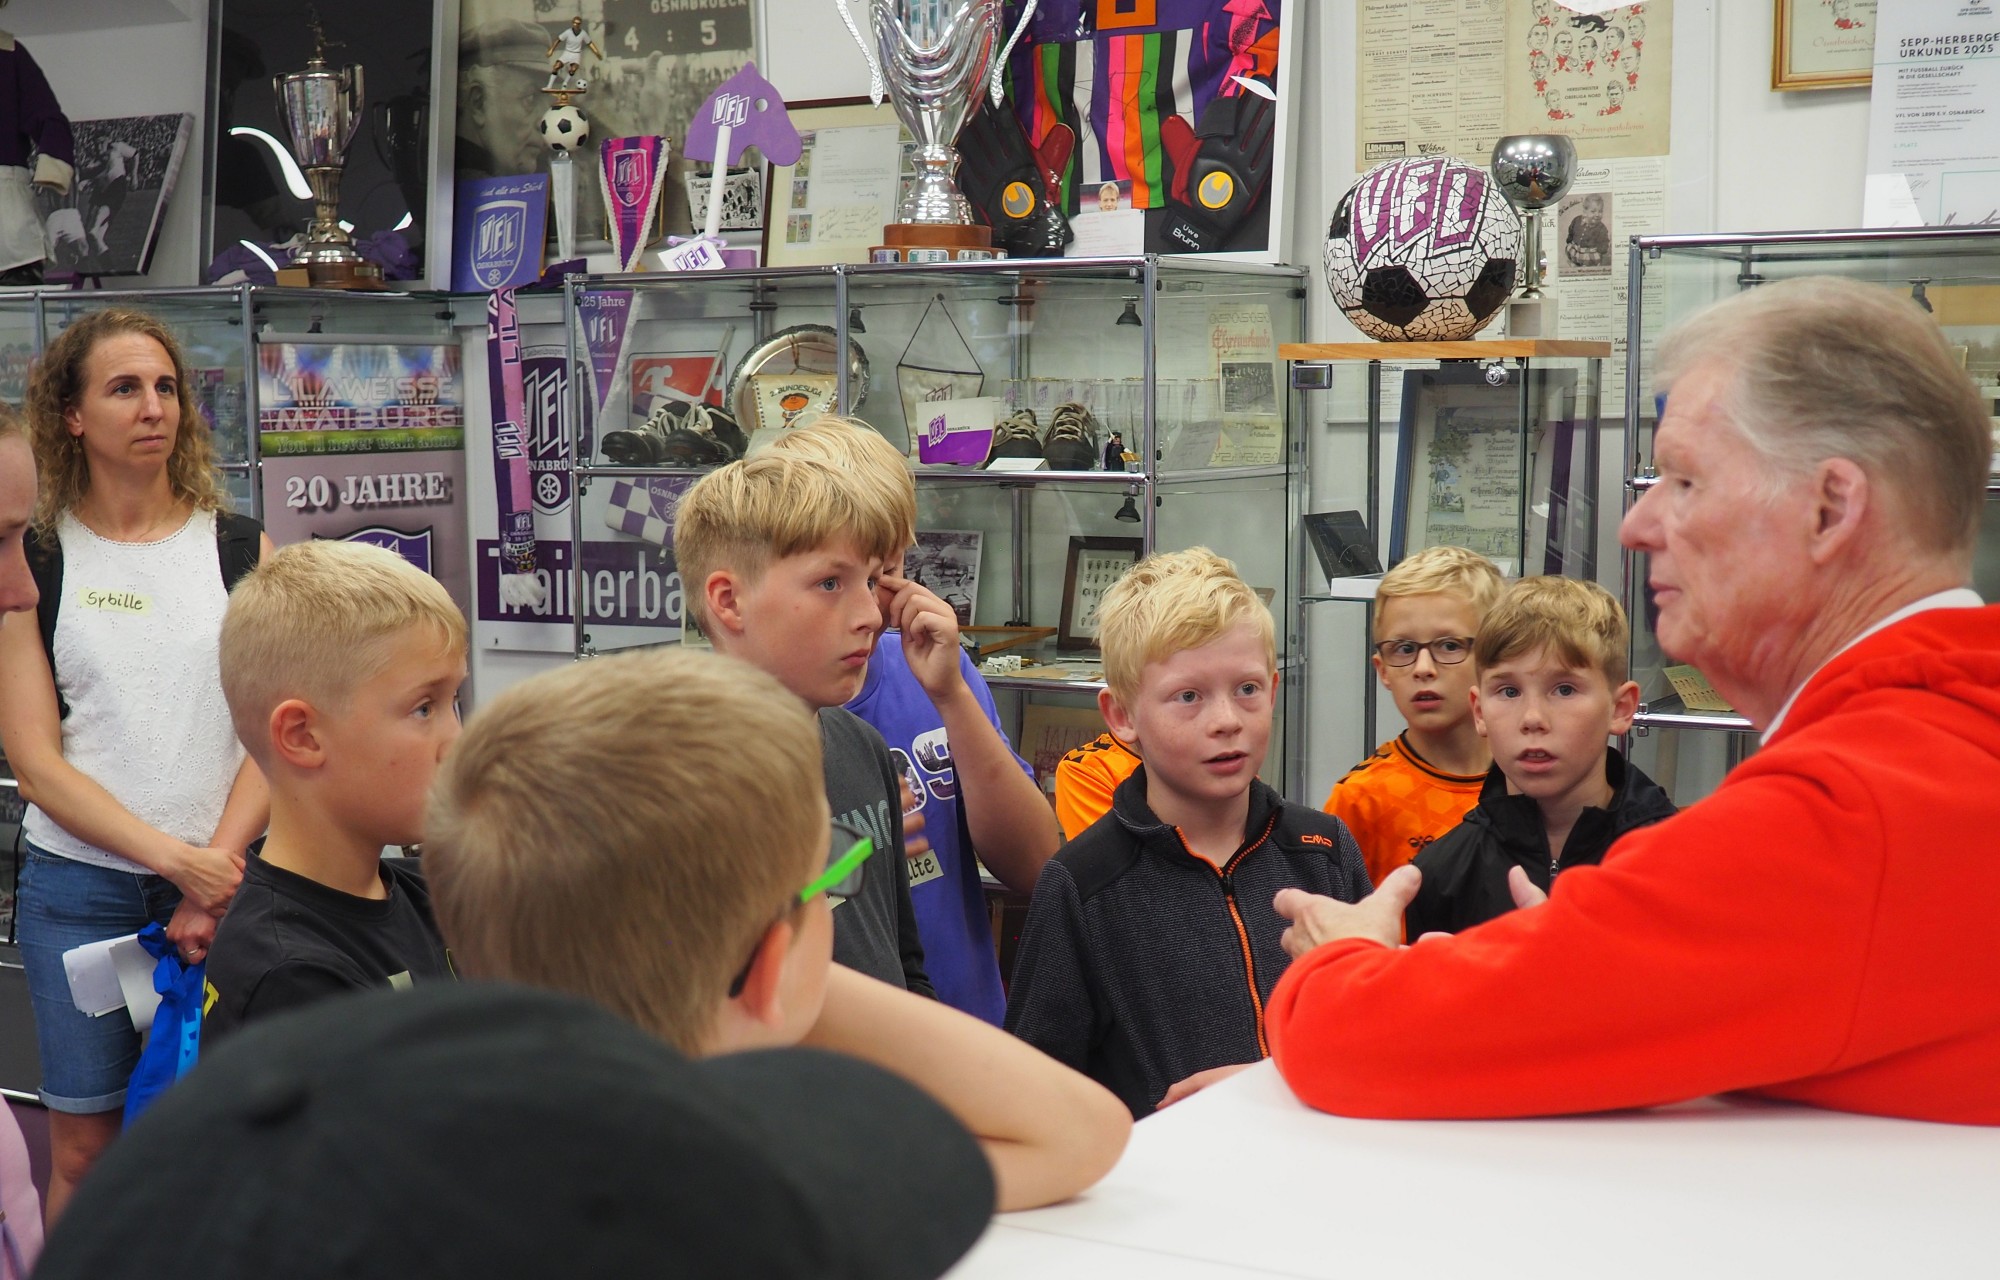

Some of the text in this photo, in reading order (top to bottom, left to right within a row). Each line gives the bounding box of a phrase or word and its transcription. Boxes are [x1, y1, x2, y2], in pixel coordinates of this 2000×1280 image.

[624, 26, 640, 52] 4
[700, 19, 717, 46] 5
[1900, 32, 2000, 47] SEPP-HERBERGE
[1899, 44, 1994, 58] URKUNDE 2025
[1917, 71, 1961, 79] GESELLSCHAFT
[713, 94, 748, 127] VFL
[479, 214, 518, 258] VFL
[1172, 227, 1200, 251] Brunn
[1182, 223, 1199, 239] Uwe
[674, 245, 709, 271] VFL
[579, 295, 626, 310] 125 Jahre
[590, 314, 617, 345] VFL
[328, 438, 376, 452] never
[378, 433, 414, 449] walk
[496, 422, 523, 459] VFL
[529, 459, 570, 471] NABRÜ
[285, 472, 444, 508] 20 JAHRE
[488, 548, 685, 620] ainerba
[909, 857, 935, 880] lte
